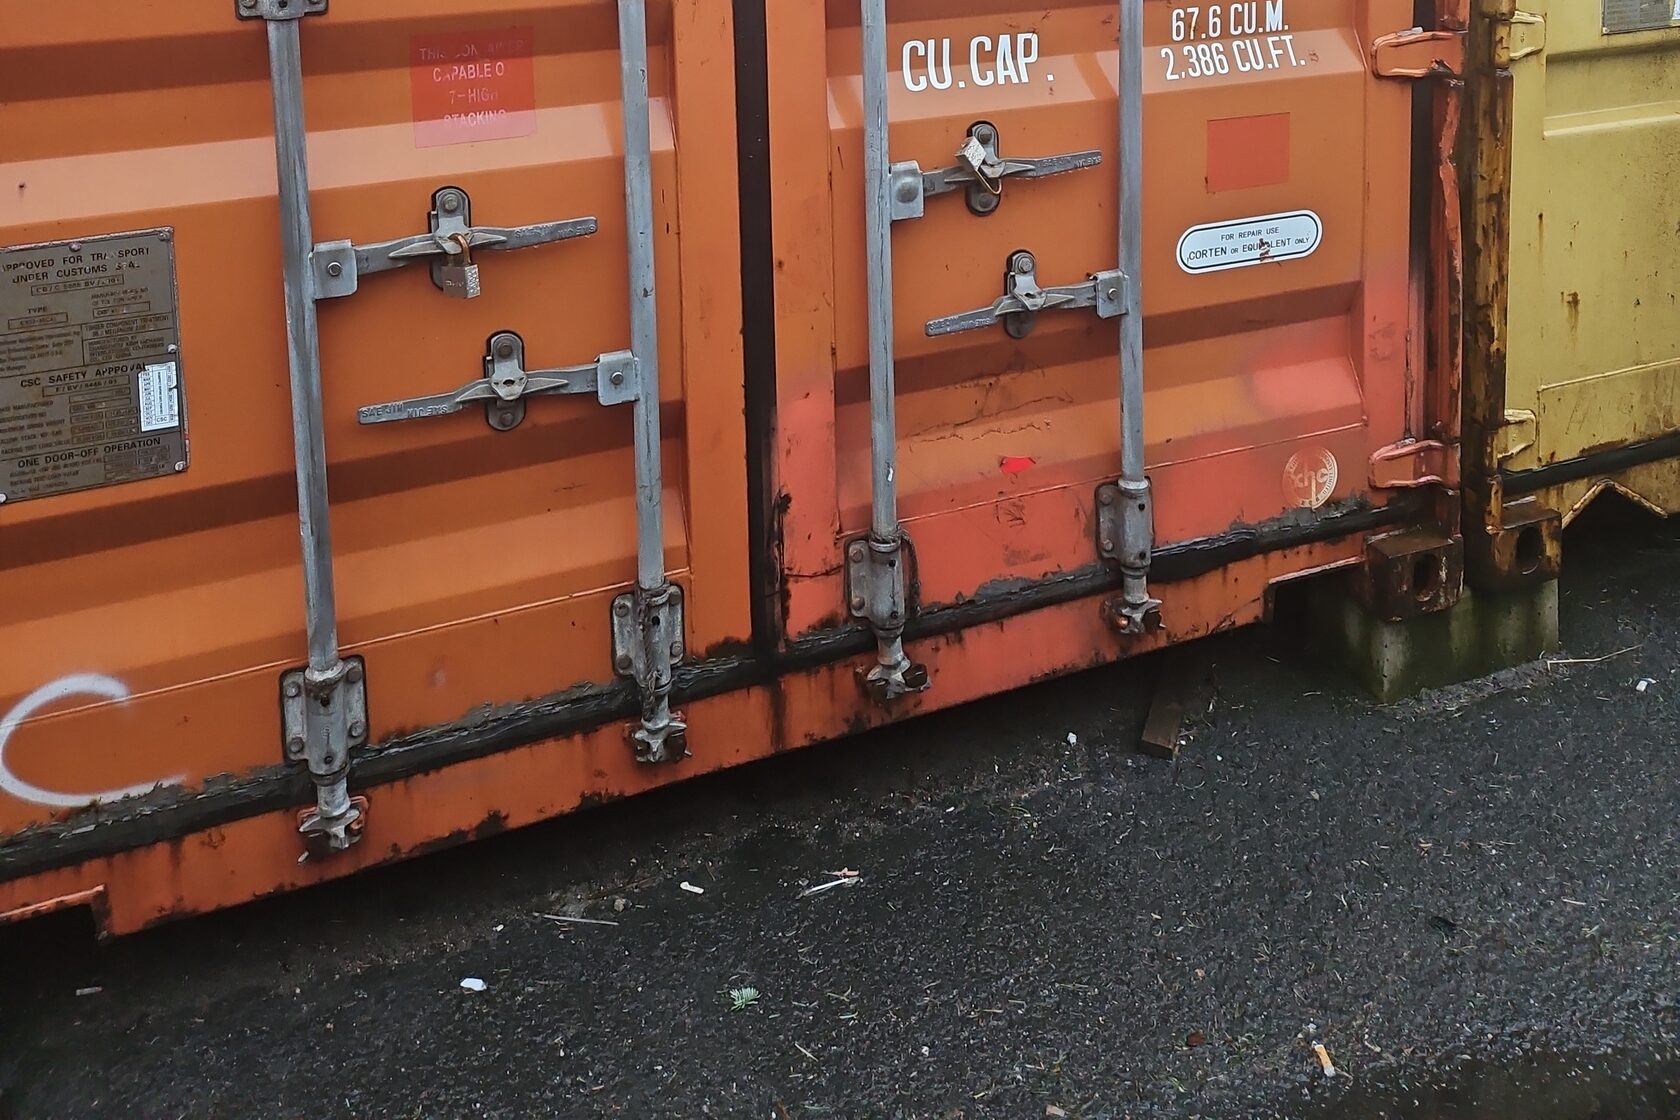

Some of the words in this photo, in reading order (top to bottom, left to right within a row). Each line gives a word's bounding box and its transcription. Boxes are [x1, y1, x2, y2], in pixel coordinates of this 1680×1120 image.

[1171, 5, 1222, 41] 67.6
[1231, 34, 1306, 72] CU.FT.
[1220, 233, 1235, 241] FOR
[1238, 229, 1263, 239] REPAIR
[1265, 226, 1280, 235] USE
[1188, 246, 1227, 260] CORTEN
[1230, 246, 1239, 254] OR
[1242, 237, 1292, 253] EQUILENT
[1294, 236, 1311, 245] ONLY
[62, 254, 83, 265] FOR
[12, 271, 49, 284] UNDER
[56, 264, 108, 278] CUSTOMS
[20, 378, 41, 388] CSC
[48, 371, 88, 384] SAFETY
[17, 458, 40, 469] ONE
[44, 447, 99, 464] DOOR-OFF
[103, 437, 161, 454] OPERATION
